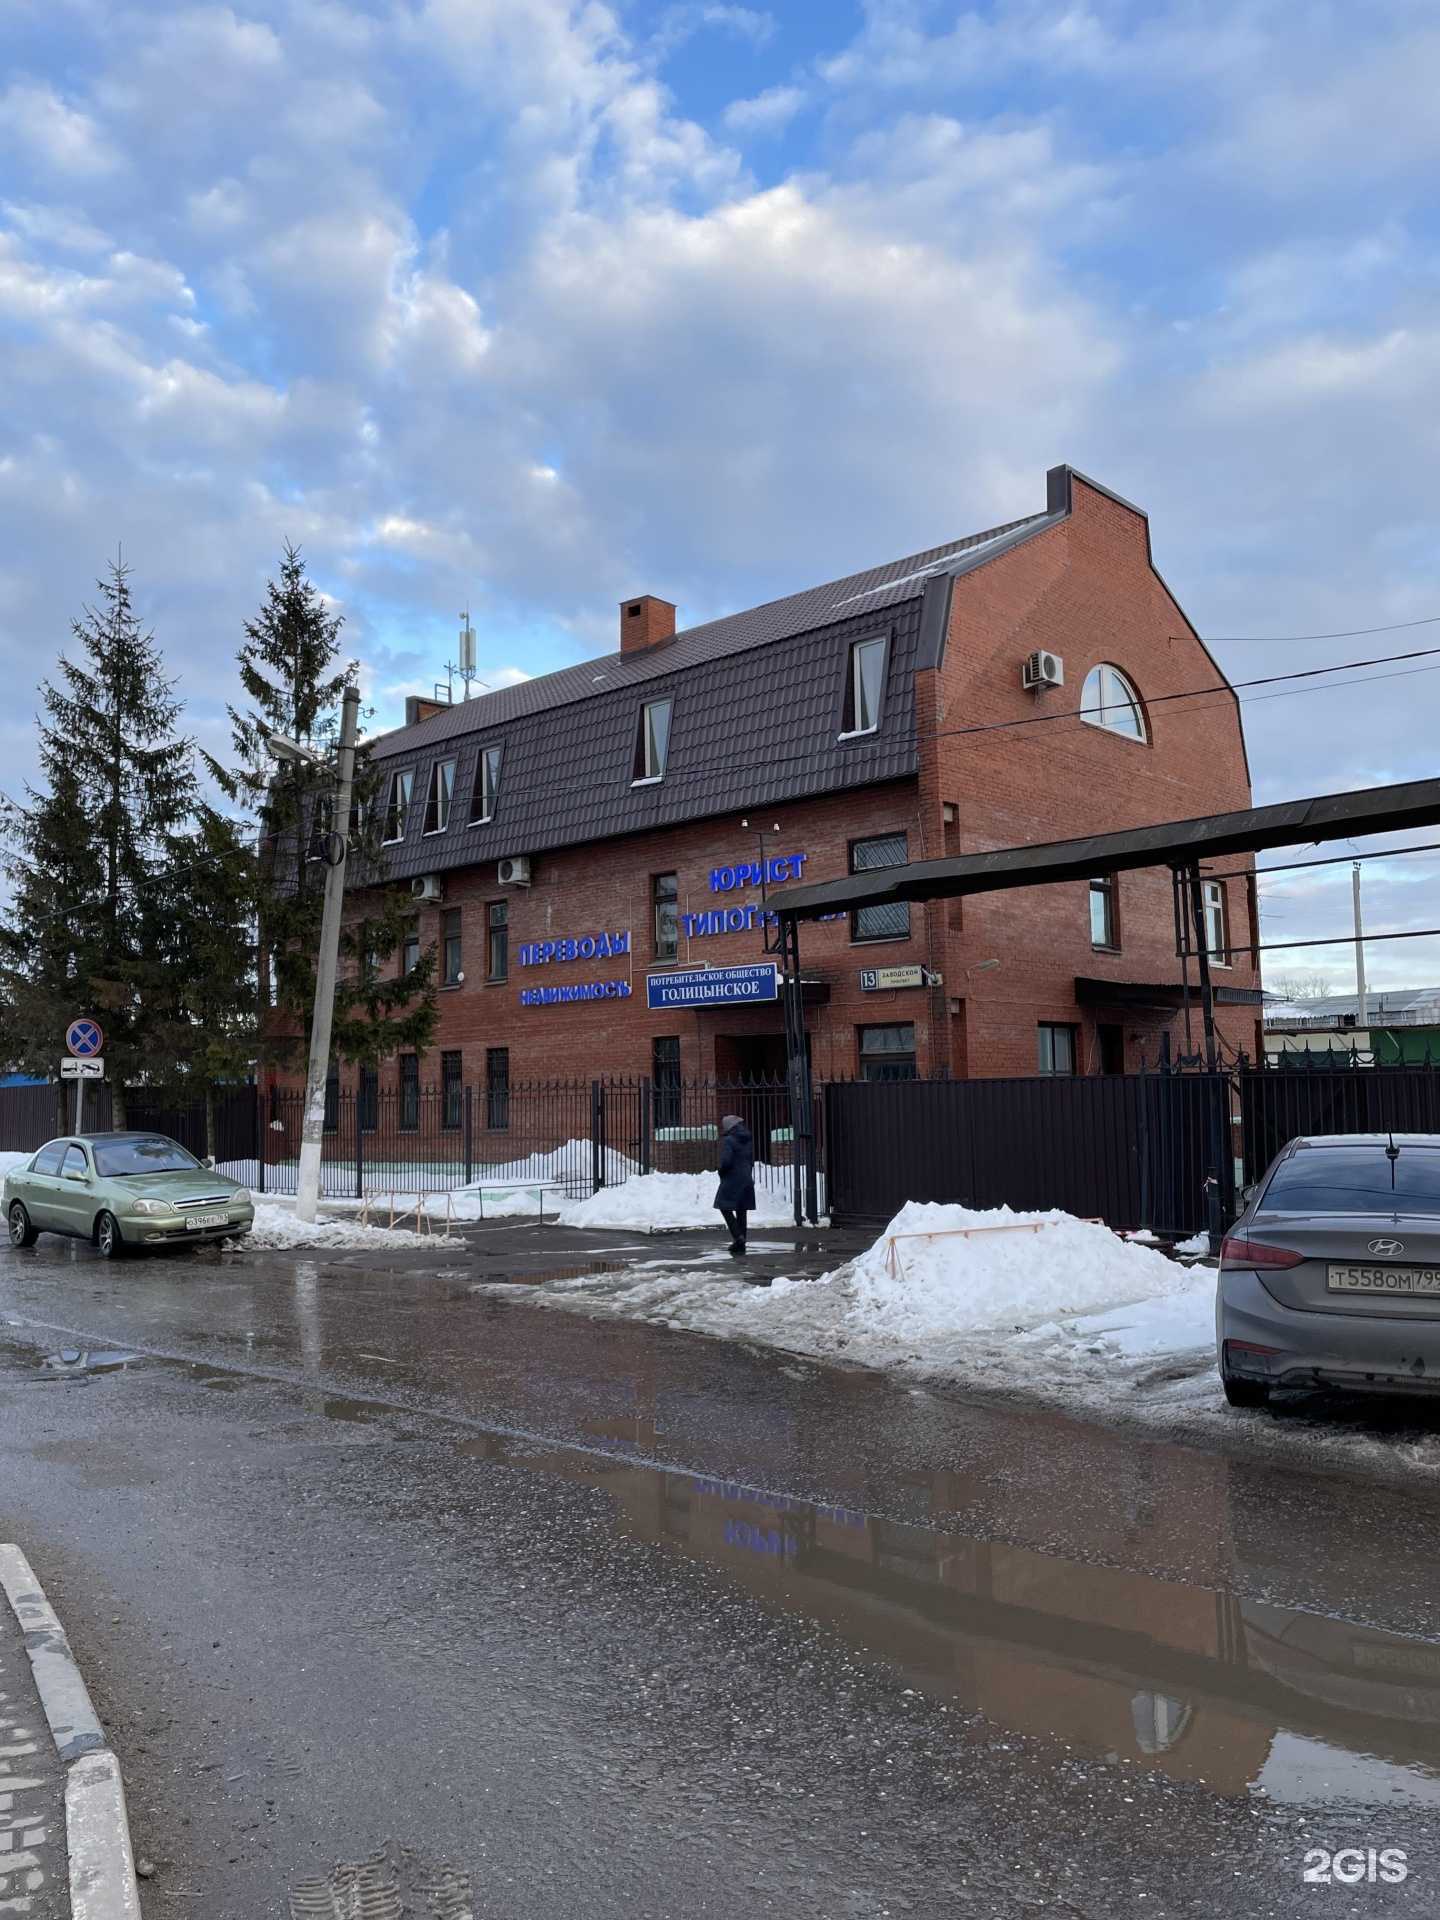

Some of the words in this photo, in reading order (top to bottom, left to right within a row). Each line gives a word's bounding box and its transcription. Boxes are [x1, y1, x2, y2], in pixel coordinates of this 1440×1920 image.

[709, 853, 807, 893] ЮРИСТ
[519, 928, 631, 967] ПЕРЕВОДЫ
[650, 970, 724, 987] ПОТРЕБИТЕЛЬСКОЕ
[725, 967, 772, 980] ОБЩЕСТВО
[863, 973, 876, 987] 13
[521, 981, 632, 1006] НЕДВИЖИМОСТЬ
[662, 981, 760, 1002] ГОЛИЦЫНСКОЕ
[1336, 1269, 1411, 1289] Т558ОМ
